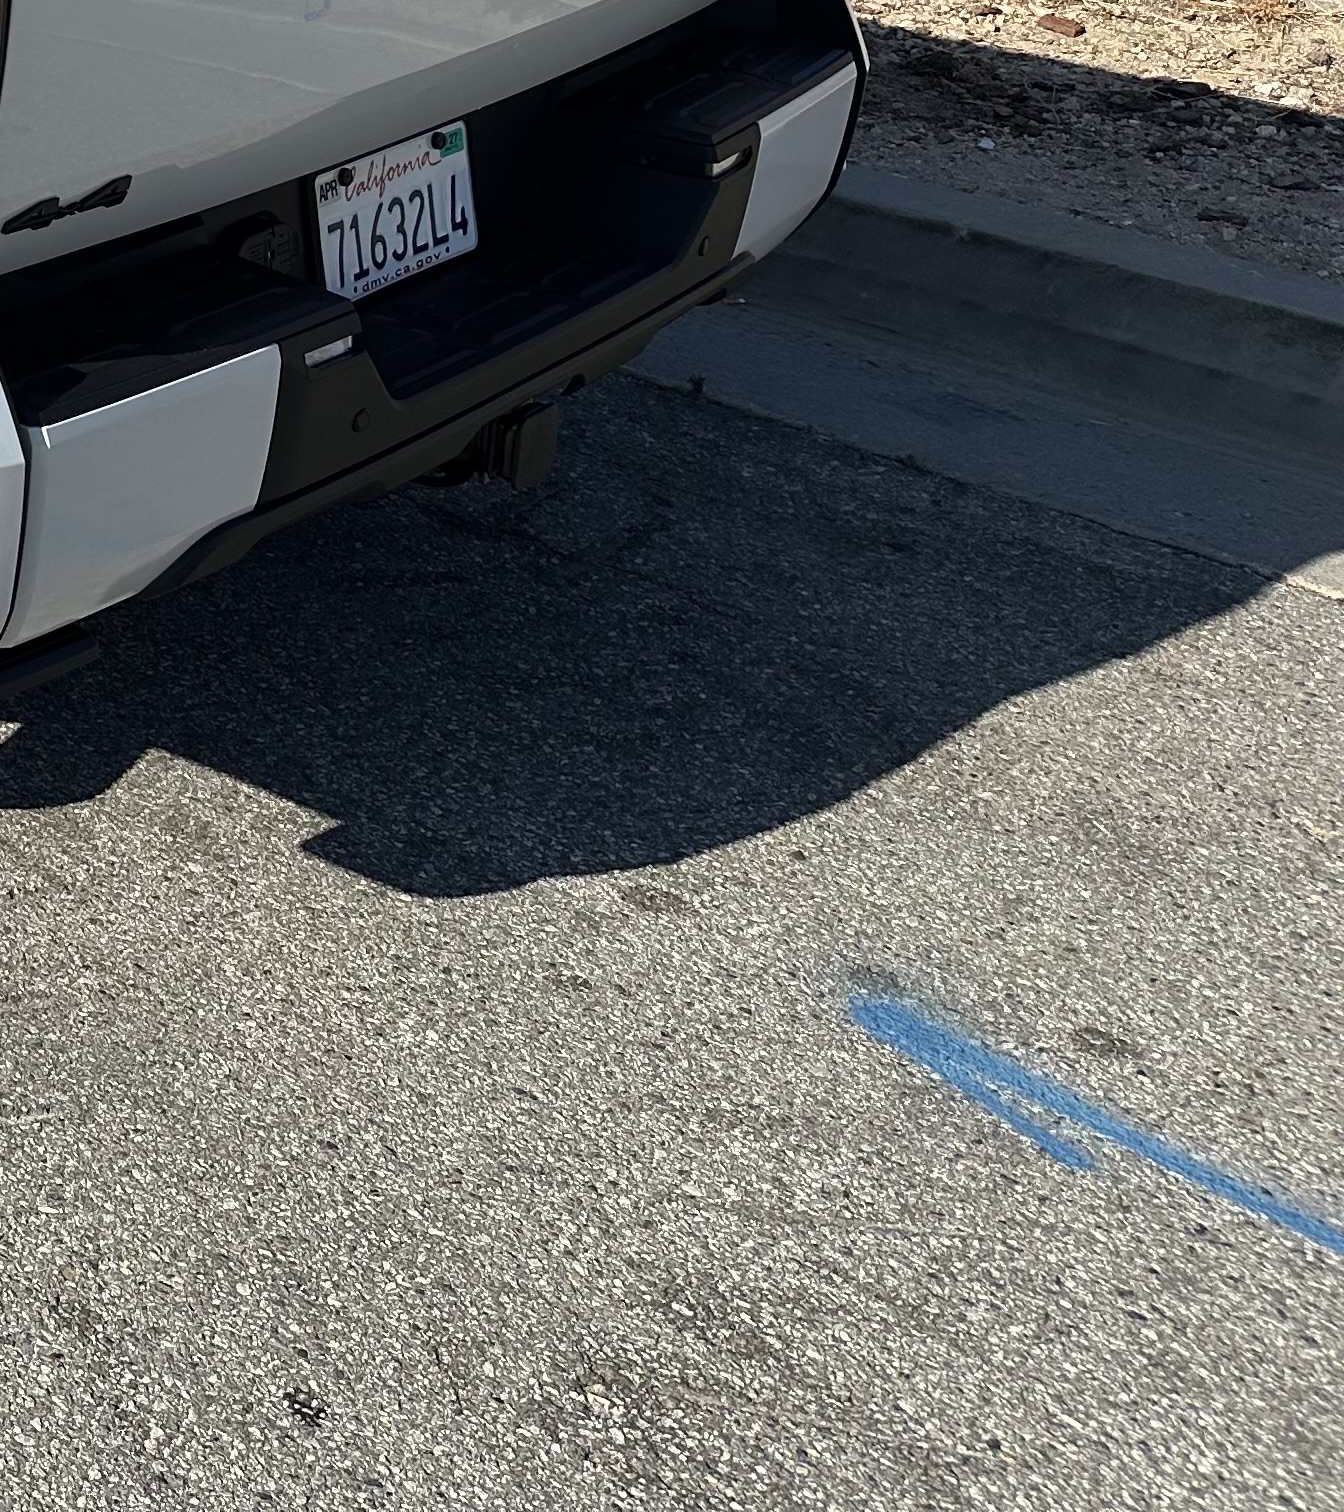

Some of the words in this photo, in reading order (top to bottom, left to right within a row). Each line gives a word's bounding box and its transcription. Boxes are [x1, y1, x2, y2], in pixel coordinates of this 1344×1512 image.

[319, 179, 339, 203] APR
[344, 150, 442, 202] California
[327, 173, 469, 289] 71632L4
[362, 250, 442, 293] dmv.ca.gov
